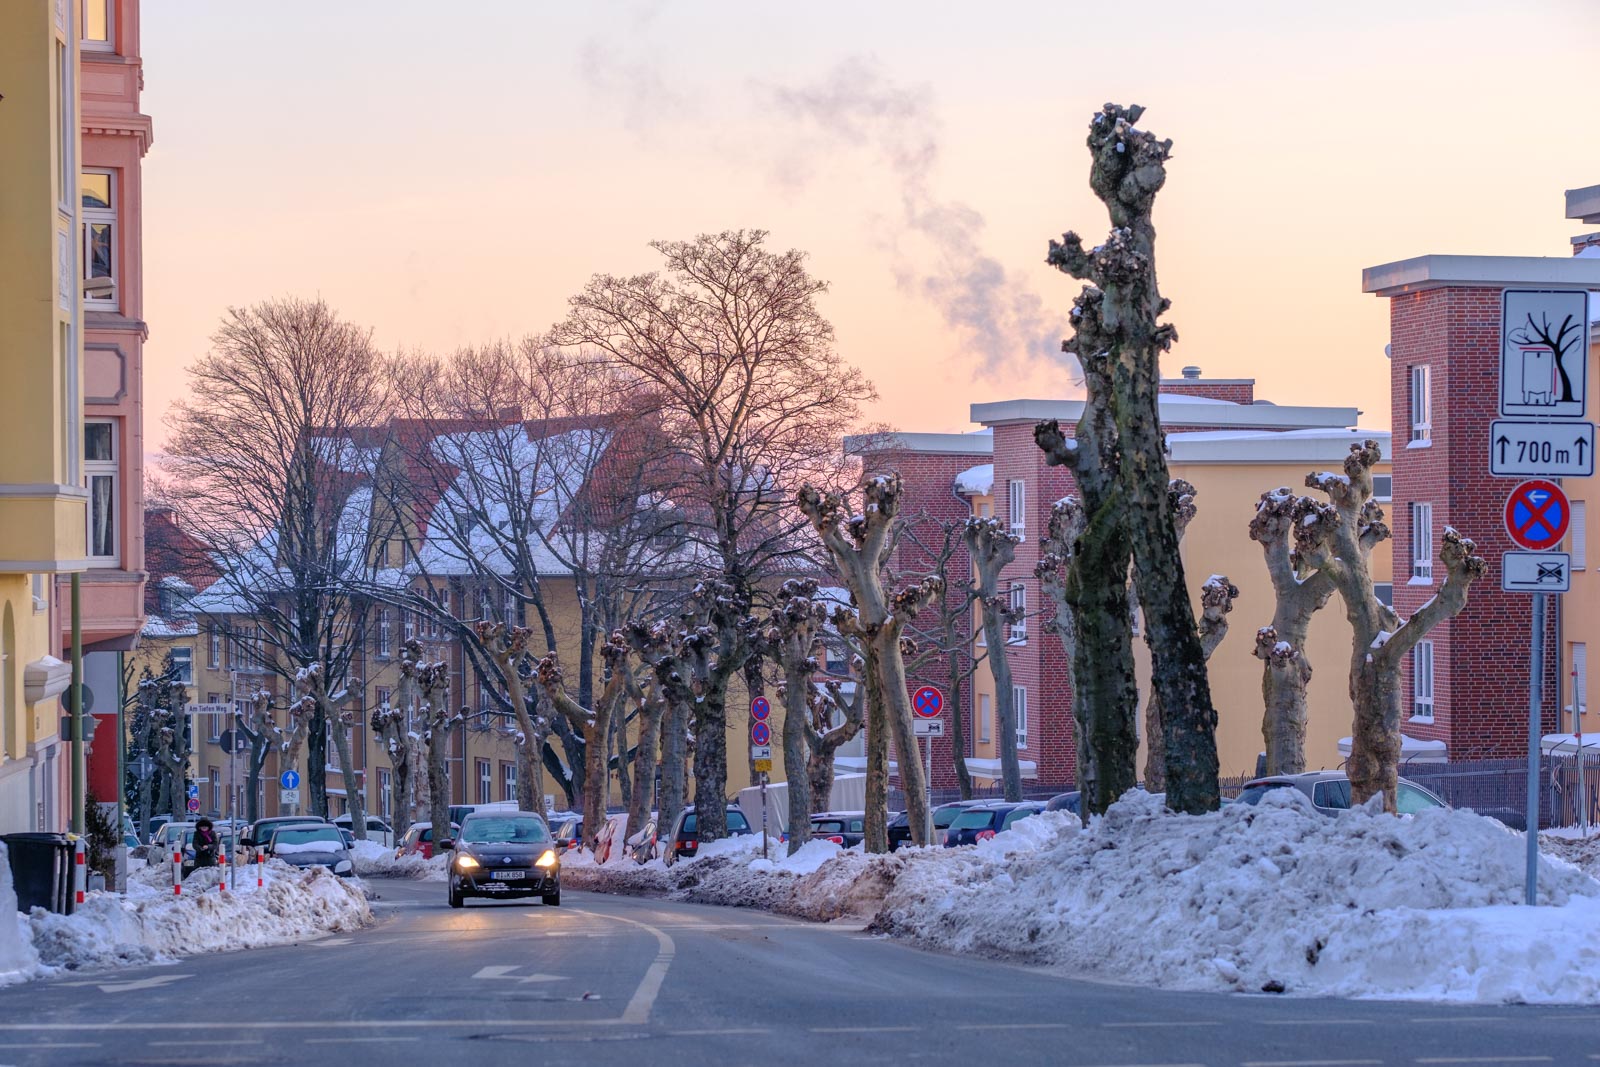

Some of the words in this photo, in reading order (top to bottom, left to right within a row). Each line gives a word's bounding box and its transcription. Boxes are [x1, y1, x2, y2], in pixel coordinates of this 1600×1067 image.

[1517, 440, 1551, 463] 700
[1555, 449, 1569, 464] m
[215, 705, 227, 713] Weg
